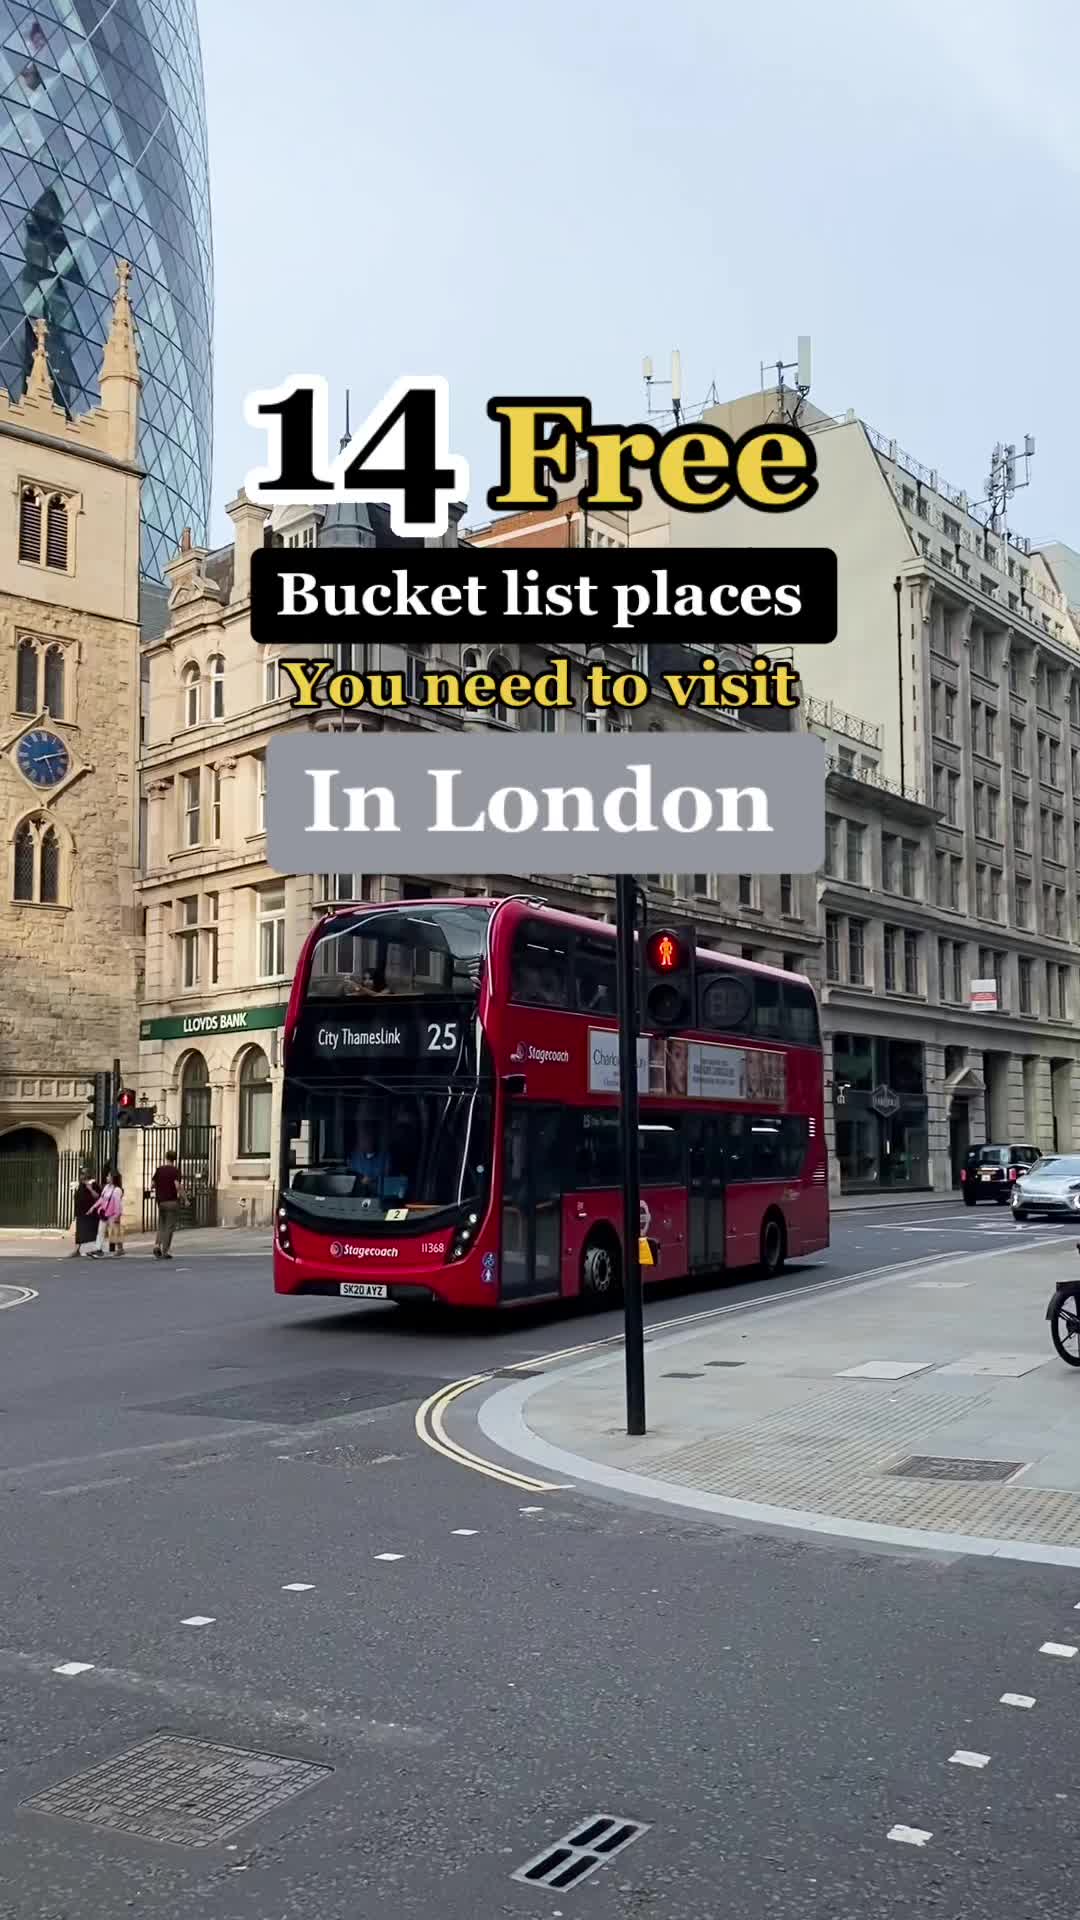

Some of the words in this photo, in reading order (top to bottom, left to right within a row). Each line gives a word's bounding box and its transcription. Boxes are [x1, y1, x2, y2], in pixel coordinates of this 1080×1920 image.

[183, 1016, 218, 1032] LLOYDS
[220, 1012, 247, 1028] BANK
[318, 1029, 339, 1050] City
[427, 1023, 457, 1051] 25
[527, 1045, 569, 1064] Stagecoach
[394, 1210, 401, 1219] 2
[343, 1244, 399, 1258] Stagecoach
[421, 1242, 445, 1253] 11368
[343, 1284, 365, 1295] SK20
[366, 1285, 384, 1297] AYZ
